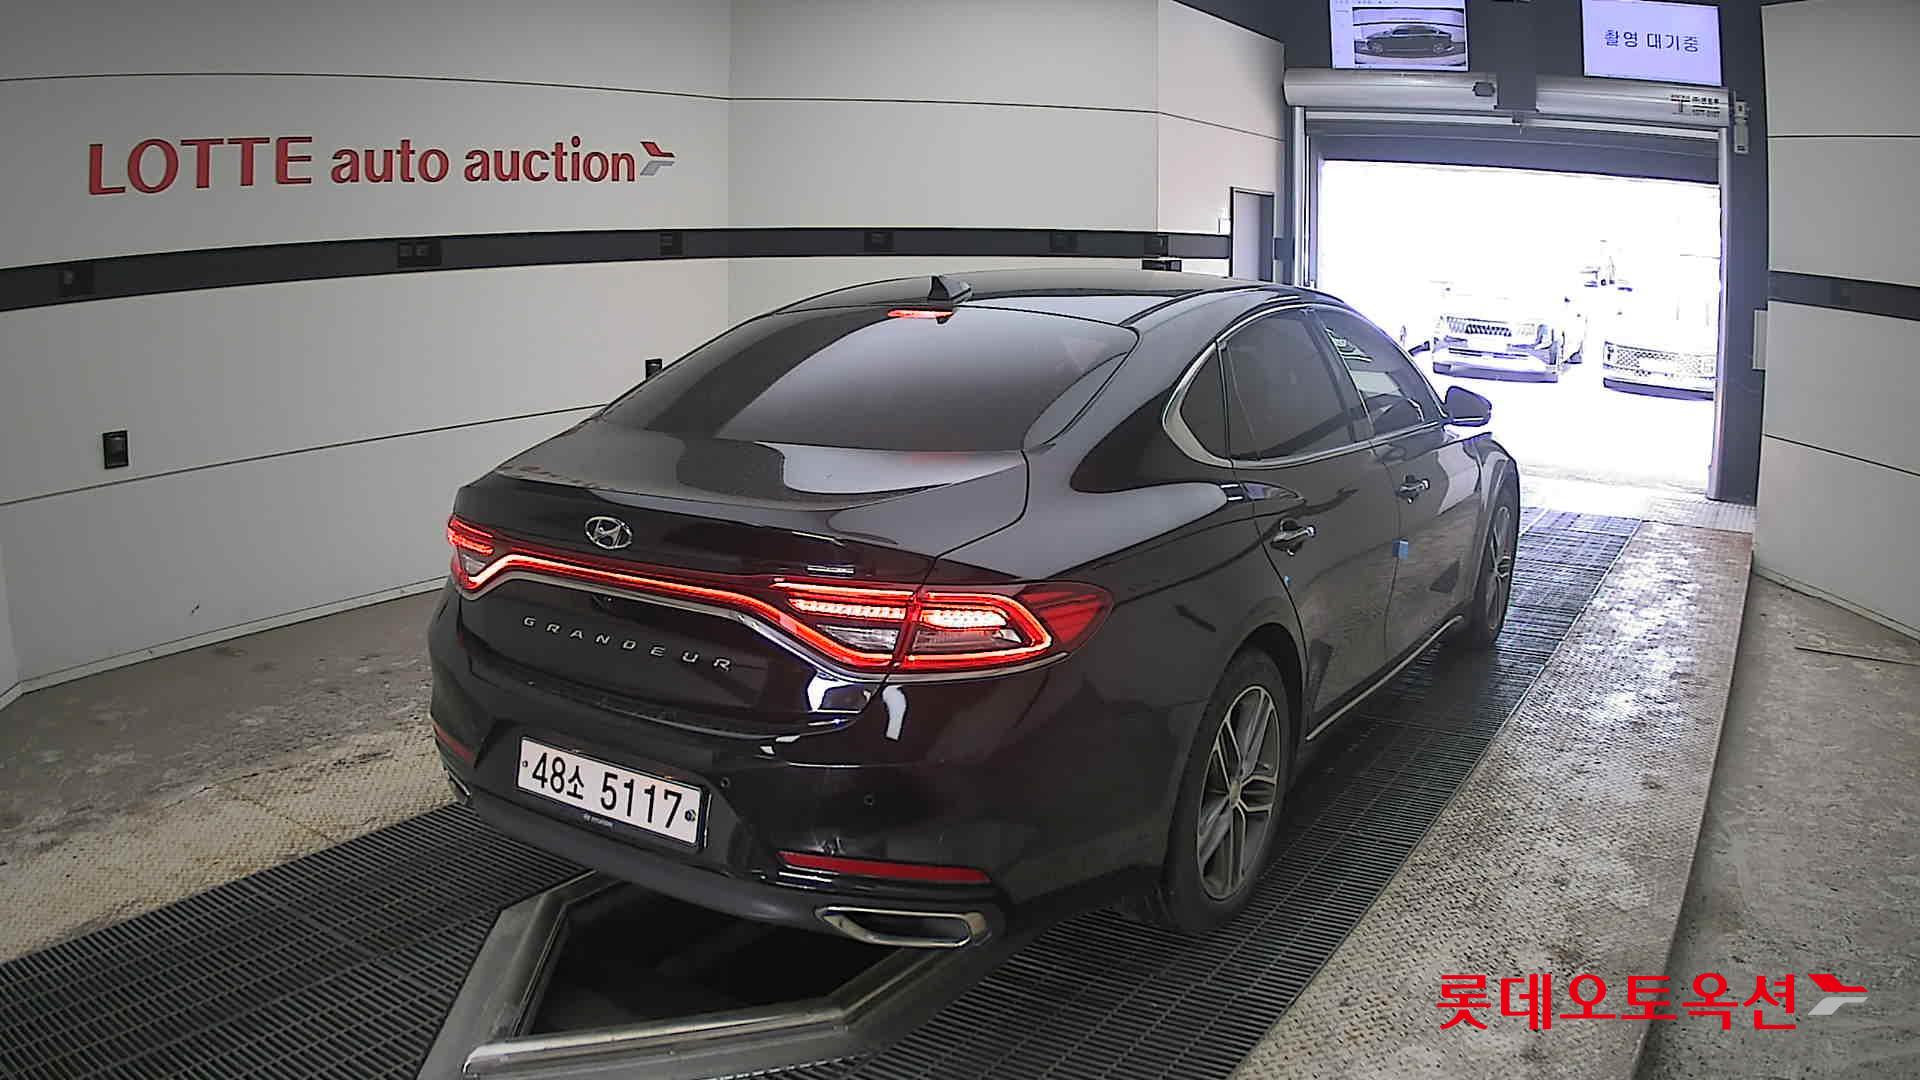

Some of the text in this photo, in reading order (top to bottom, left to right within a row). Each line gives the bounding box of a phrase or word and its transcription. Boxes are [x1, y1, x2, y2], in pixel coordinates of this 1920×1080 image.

[1646, 32, 1698, 53] 대기중
[88, 135, 637, 196] LOTTE auto auction
[522, 615, 732, 672] GRANDEUR
[532, 752, 683, 829] 48소 5117
